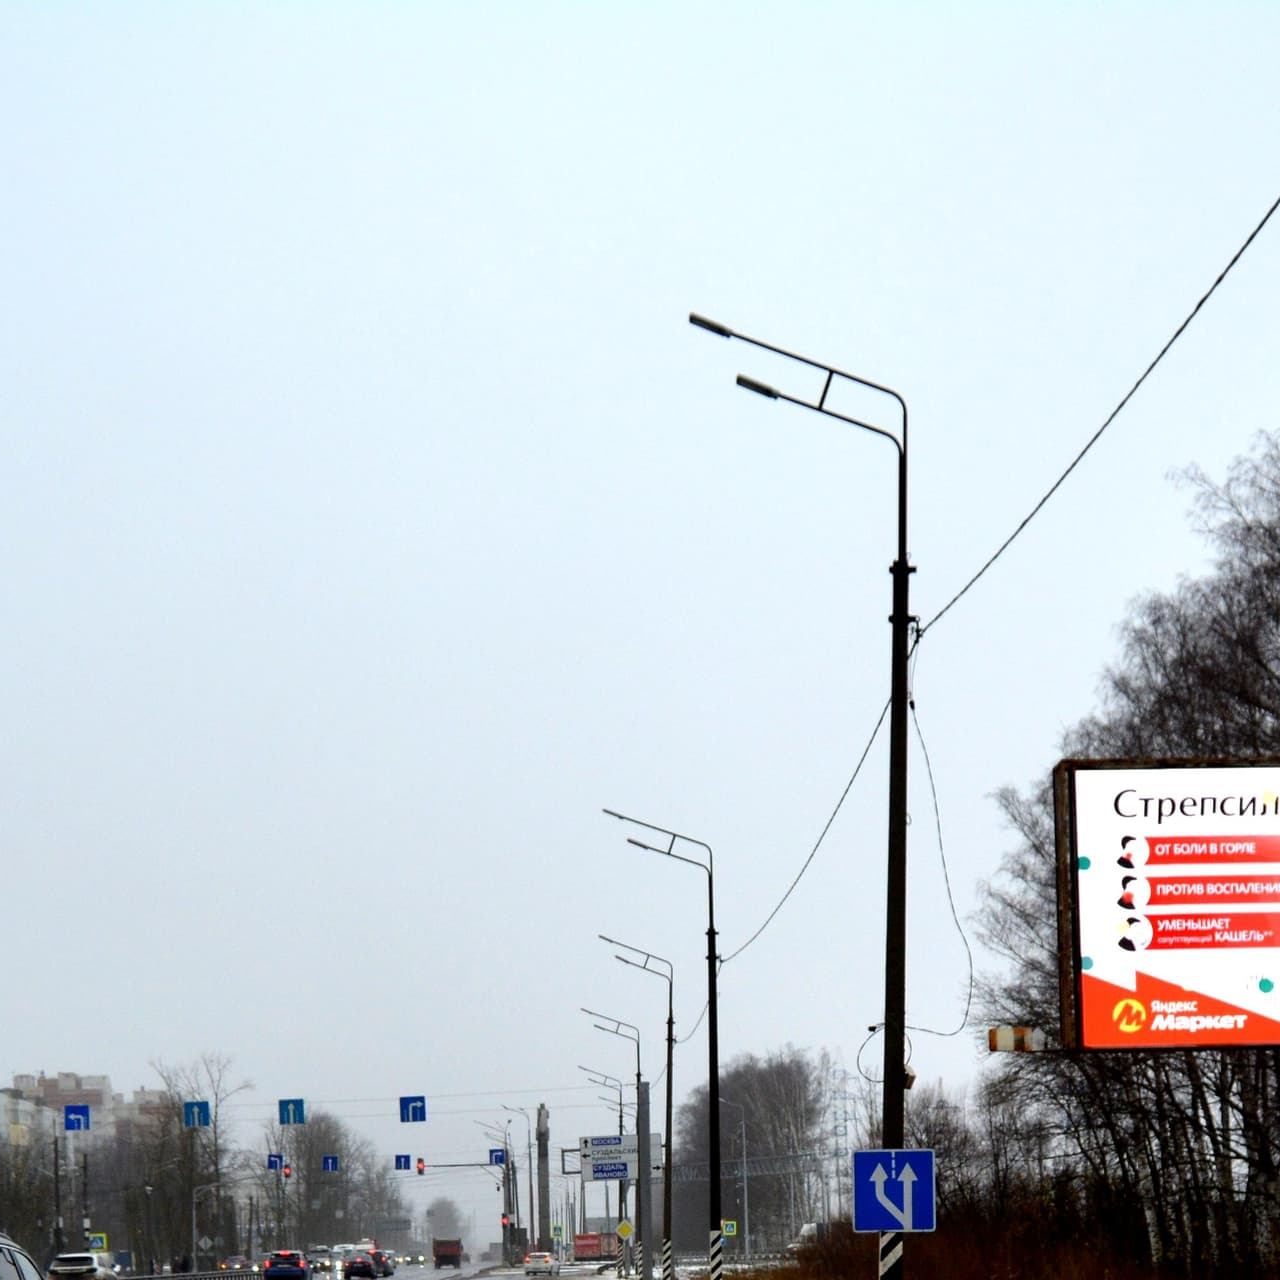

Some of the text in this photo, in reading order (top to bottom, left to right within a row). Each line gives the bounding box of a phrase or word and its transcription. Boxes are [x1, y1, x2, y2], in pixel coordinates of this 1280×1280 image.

[1155, 841, 1256, 855] ОТ БОЛИ В ГОРЛЕ
[1156, 883, 1204, 896] ПРОТИВ
[1157, 918, 1231, 931] УМЕНЬШАЕТ
[1151, 1000, 1198, 1014] Яндекс
[1150, 1014, 1248, 1032] Маркет
